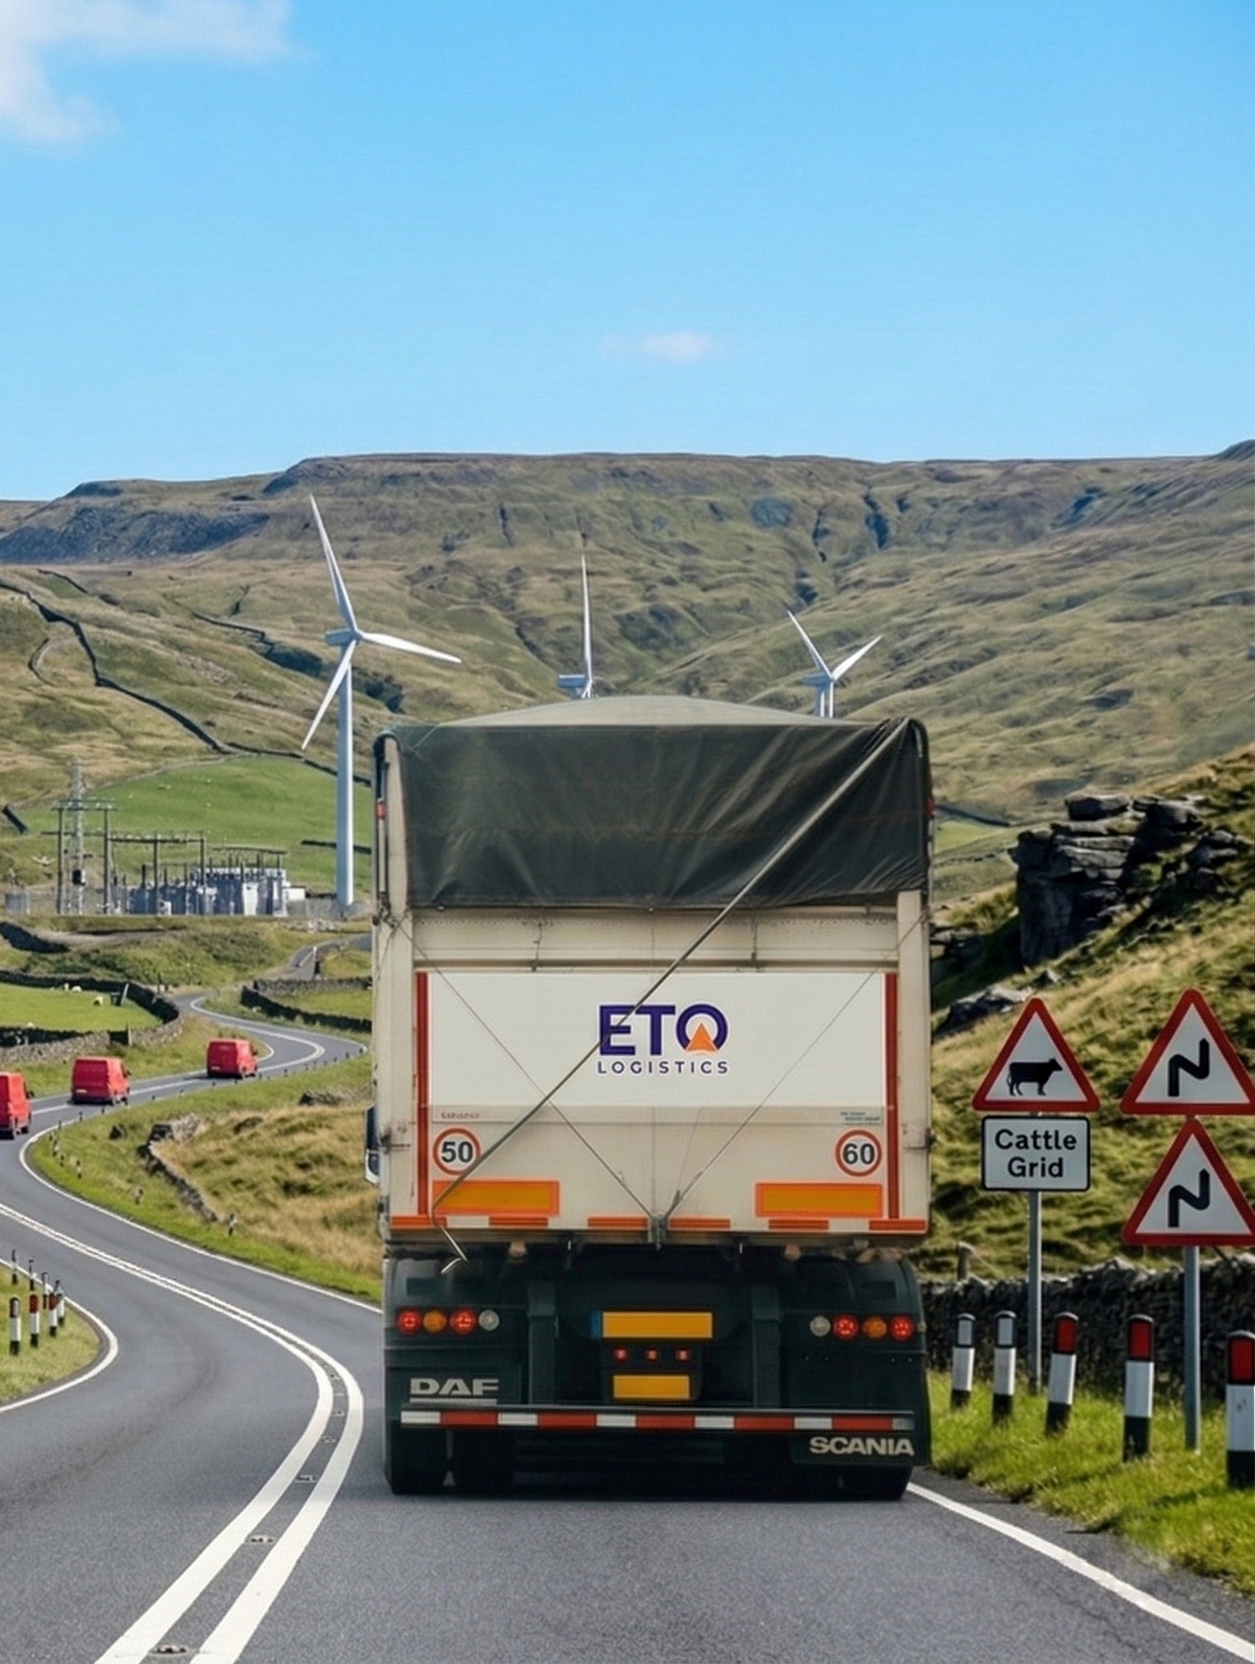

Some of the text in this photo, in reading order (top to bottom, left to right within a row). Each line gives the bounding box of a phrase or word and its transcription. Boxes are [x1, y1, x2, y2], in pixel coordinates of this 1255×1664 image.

[597, 1061, 728, 1074] LOGISTICS
[994, 1128, 1078, 1151] Cattle
[440, 1142, 474, 1164] 50
[842, 1143, 876, 1166] 60
[1007, 1156, 1064, 1179] Grid
[410, 1377, 499, 1396] DAF
[809, 1436, 915, 1456] SCANIA
